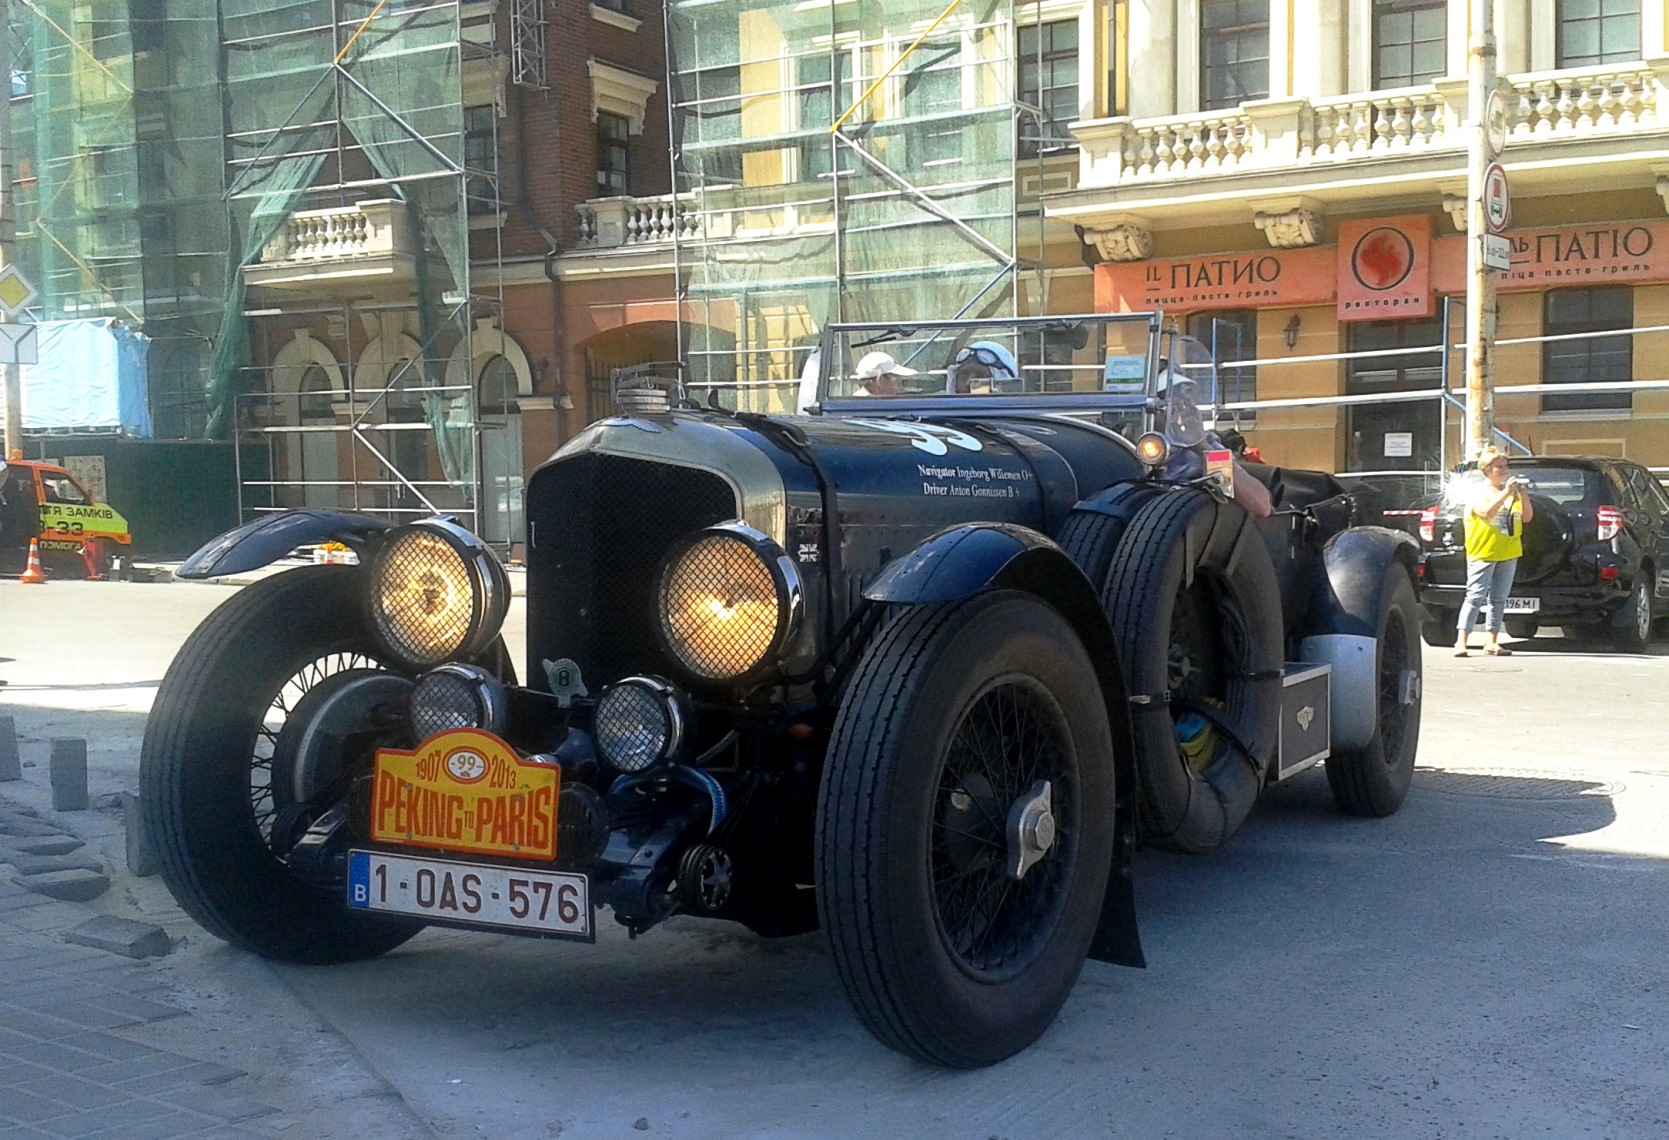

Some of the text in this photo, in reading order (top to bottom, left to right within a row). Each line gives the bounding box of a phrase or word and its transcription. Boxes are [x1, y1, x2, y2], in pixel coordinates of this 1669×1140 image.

[1536, 227, 1654, 263] ПАТІО
[1170, 256, 1281, 289] ПАТИО
[1545, 267, 1591, 278] паста
[1602, 264, 1650, 274] гриль
[1193, 293, 1230, 302] паста
[1238, 289, 1278, 299] гриль
[1345, 297, 1420, 309] ресторан
[917, 464, 956, 480] Navigator
[957, 466, 988, 482] Ingeborg
[923, 482, 948, 496] Driver
[949, 484, 970, 496] Anton
[66, 507, 113, 519] ЗАМКІВ
[415, 750, 442, 782] 1907
[488, 755, 517, 790] 2013
[378, 769, 552, 850] PEKING TO PARIS
[354, 883, 367, 902] B
